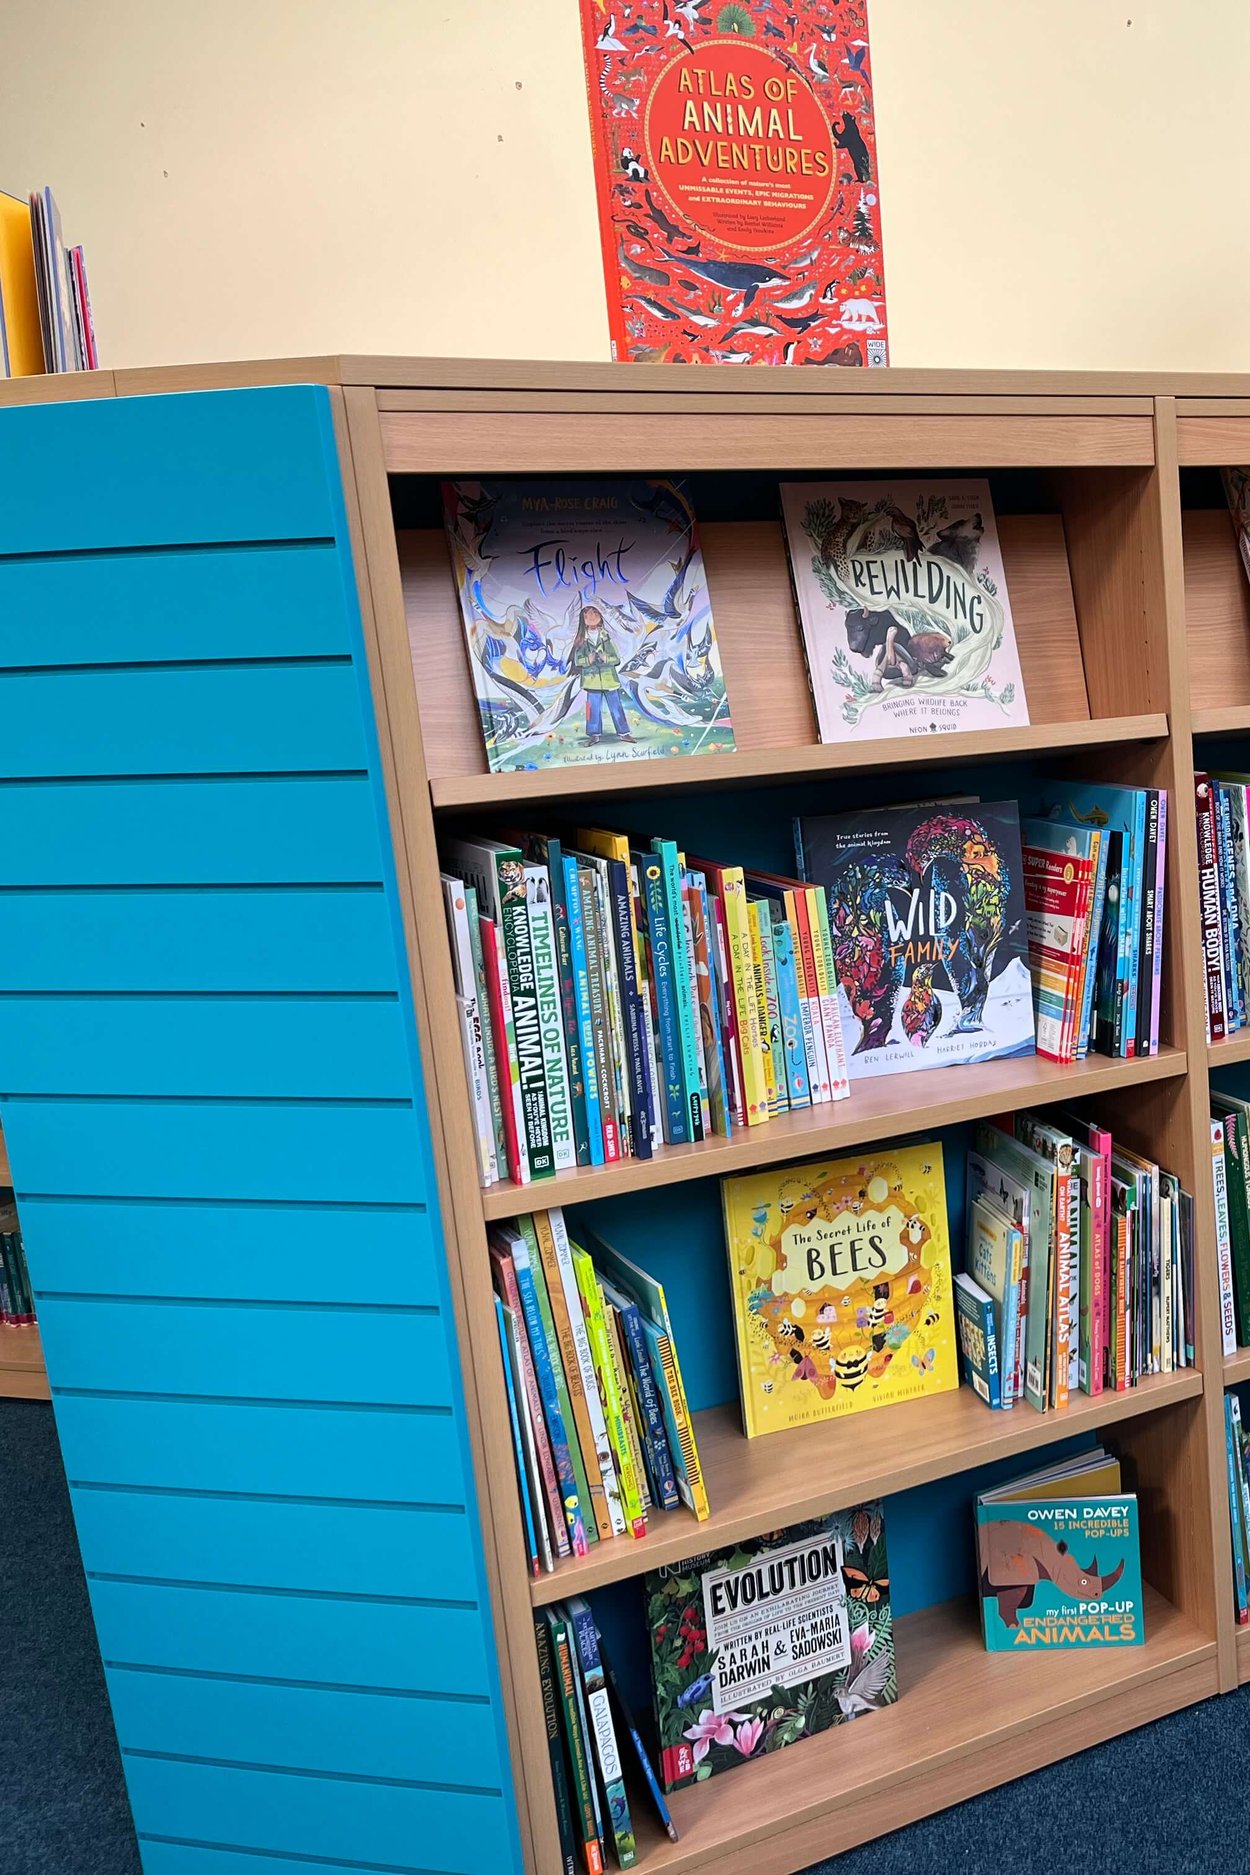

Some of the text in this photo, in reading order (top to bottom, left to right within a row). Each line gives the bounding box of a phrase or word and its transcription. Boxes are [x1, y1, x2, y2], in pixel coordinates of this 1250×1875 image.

[678, 67, 798, 104] ATLAS OF
[683, 99, 803, 141] ANIMAL
[659, 136, 829, 177] ADVENTURES
[678, 184, 724, 193] UNMISSABLE
[772, 191, 814, 200] MIGRATIONS
[518, 537, 638, 602] Flight
[852, 559, 984, 634] REWILDING
[882, 698, 968, 712] BRINGING WILDLIFE BACK
[893, 708, 917, 718] WHERE
[931, 708, 960, 716] BELONGS
[909, 723, 957, 734] NEON SQUID
[874, 830, 889, 838] from
[1202, 811, 1213, 865] KNOWLEDGE
[884, 888, 957, 943] WILD
[1202, 868, 1218, 973] HUMAN BODY!
[503, 907, 520, 993] ENCYCLOPEDIA
[512, 906, 534, 991] KNOWLEDGE
[617, 894, 634, 981] AMAZING ANIMALS
[654, 917, 667, 977] Life Cycles
[889, 938, 960, 967] FAMILY
[753, 963, 764, 998] ANIMALS
[531, 911, 570, 1143] TIMELINES NATURE
[757, 1005, 768, 1037] DANGER
[800, 1002, 815, 1068] EMPEROR PENGUIN
[513, 996, 544, 1090] ANIMAL!
[792, 1216, 892, 1246] The Secret Life of
[1214, 1157, 1234, 1336] TREES, LEAVES, FLOWERS SEEDS
[806, 1235, 888, 1282] BEES
[1058, 1231, 1071, 1343] ANIMAL ATLAS
[579, 1349, 596, 1391] BOOK BUGS
[987, 1334, 998, 1375] INSECTS
[669, 1382, 677, 1397] BEE
[672, 1397, 683, 1417] BOOK
[1027, 1506, 1129, 1520] OWEN DAVEY
[1054, 1519, 1129, 1530] 15 INCREDIBLE
[1085, 1529, 1130, 1538] POP-UPS
[710, 1543, 838, 1618] EVOLUTION
[723, 1604, 834, 1651] WRITTEN BY REAL-LIFE SCIENTISTS
[790, 1613, 841, 1643] EVA-MARIA
[1023, 1615, 1135, 1628] ENDANGERED
[1046, 1601, 1134, 1618] my first POP-UP
[791, 1627, 842, 1661] SADOWSKI
[1013, 1624, 1136, 1645] ANIMALS
[558, 1643, 574, 1697] HUMANIMAL
[719, 1640, 788, 1689] DARWIN &
[592, 1694, 618, 1775] GALAPAGOS
